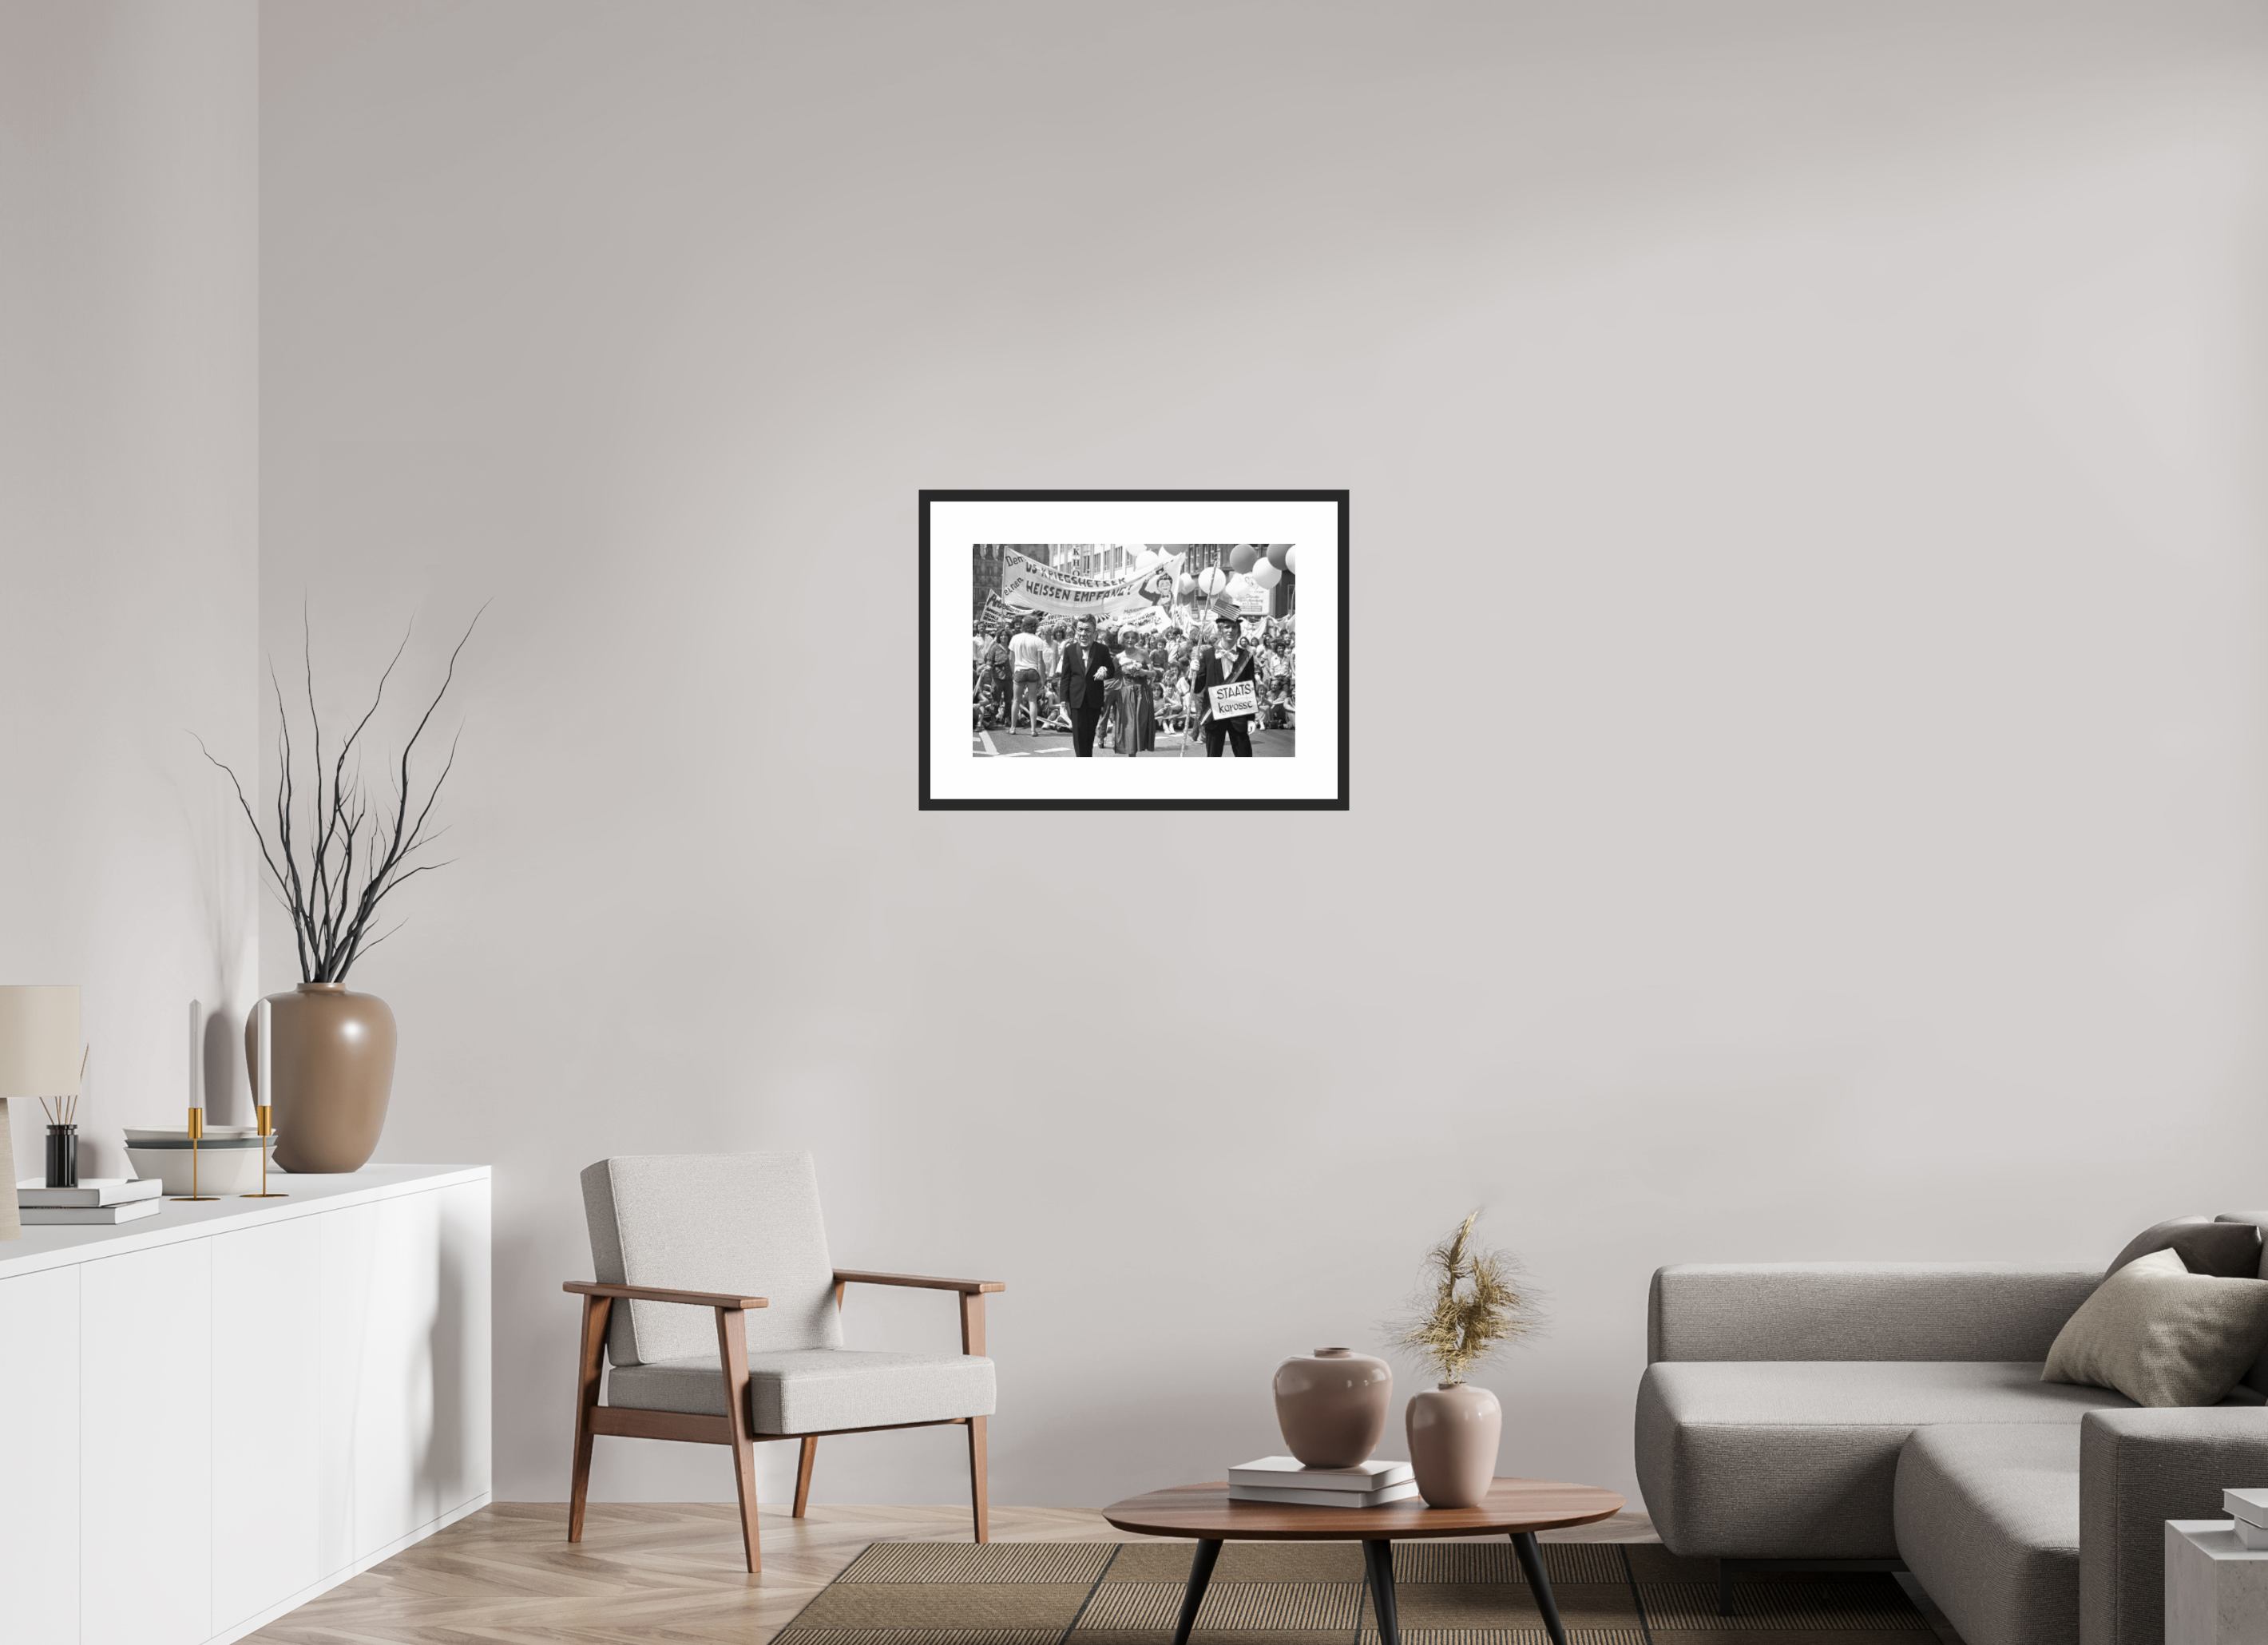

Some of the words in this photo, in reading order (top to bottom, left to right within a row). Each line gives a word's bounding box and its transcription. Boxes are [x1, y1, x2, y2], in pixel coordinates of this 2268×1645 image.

[1005, 556, 1026, 567] Dem
[1004, 577, 1024, 596] einen
[1026, 581, 1071, 601] HEISSEN
[1074, 584, 1134, 602] EMPFANG!
[1218, 700, 1253, 713] karosse
